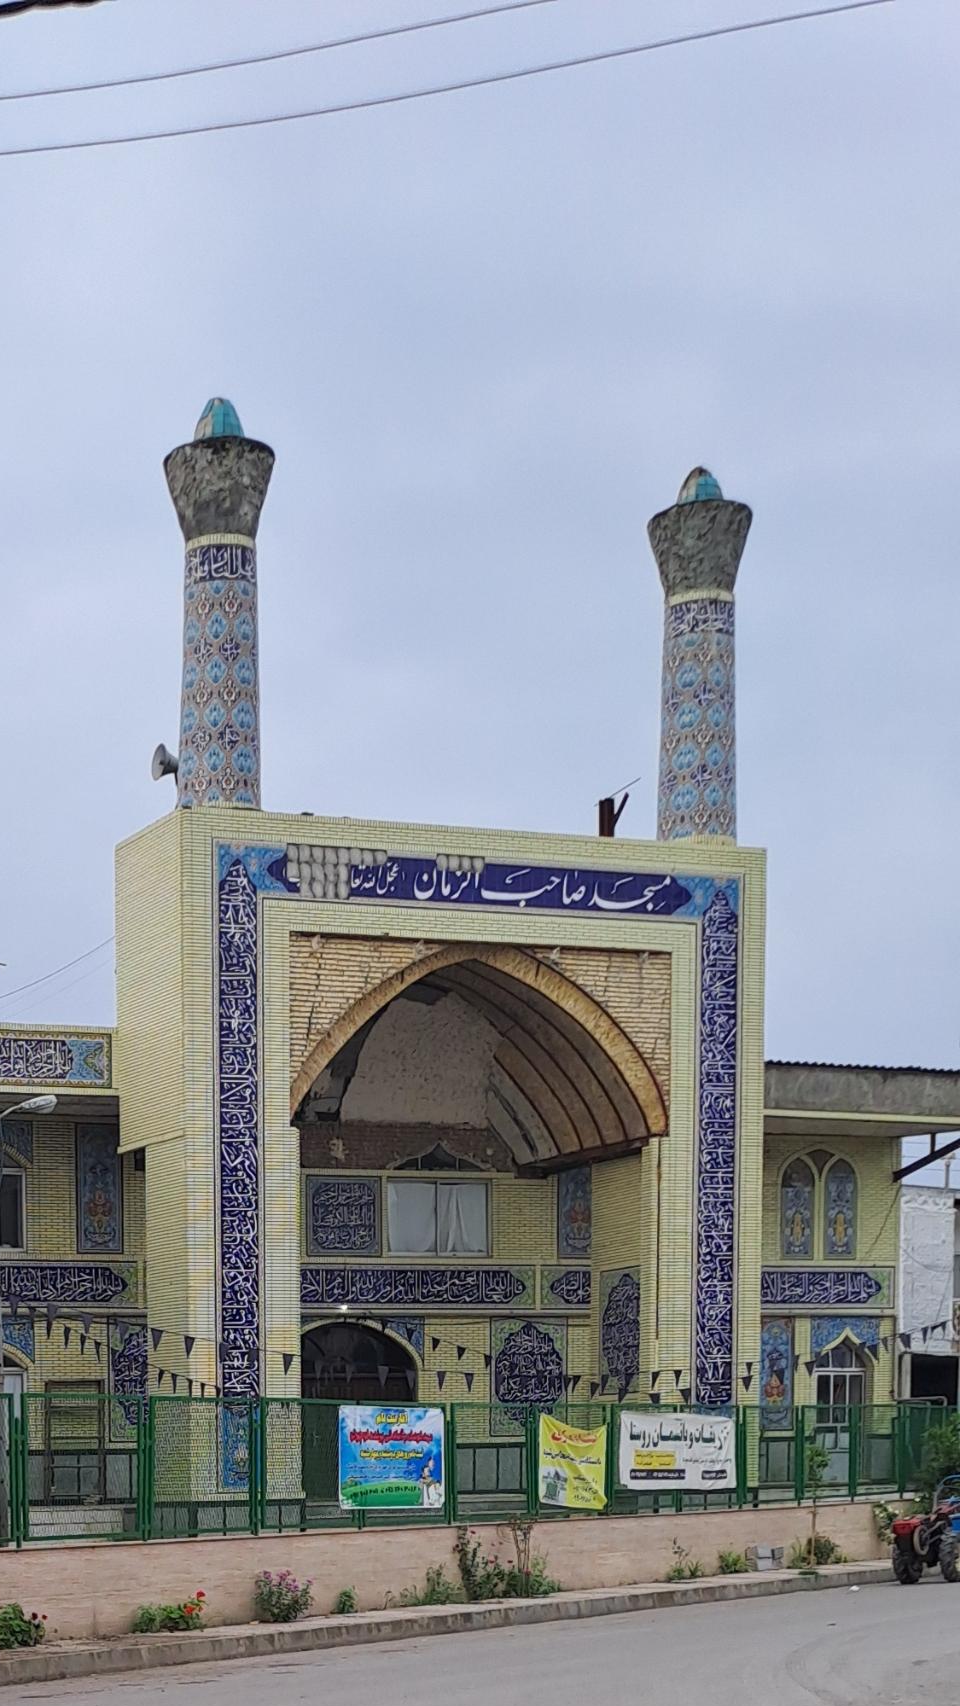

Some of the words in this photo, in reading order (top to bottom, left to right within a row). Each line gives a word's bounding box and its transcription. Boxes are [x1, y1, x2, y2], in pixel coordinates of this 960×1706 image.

[480, 868, 586, 908] صاحب
[587, 875, 671, 912] مسجد
[629, 1420, 651, 1449] روستا
